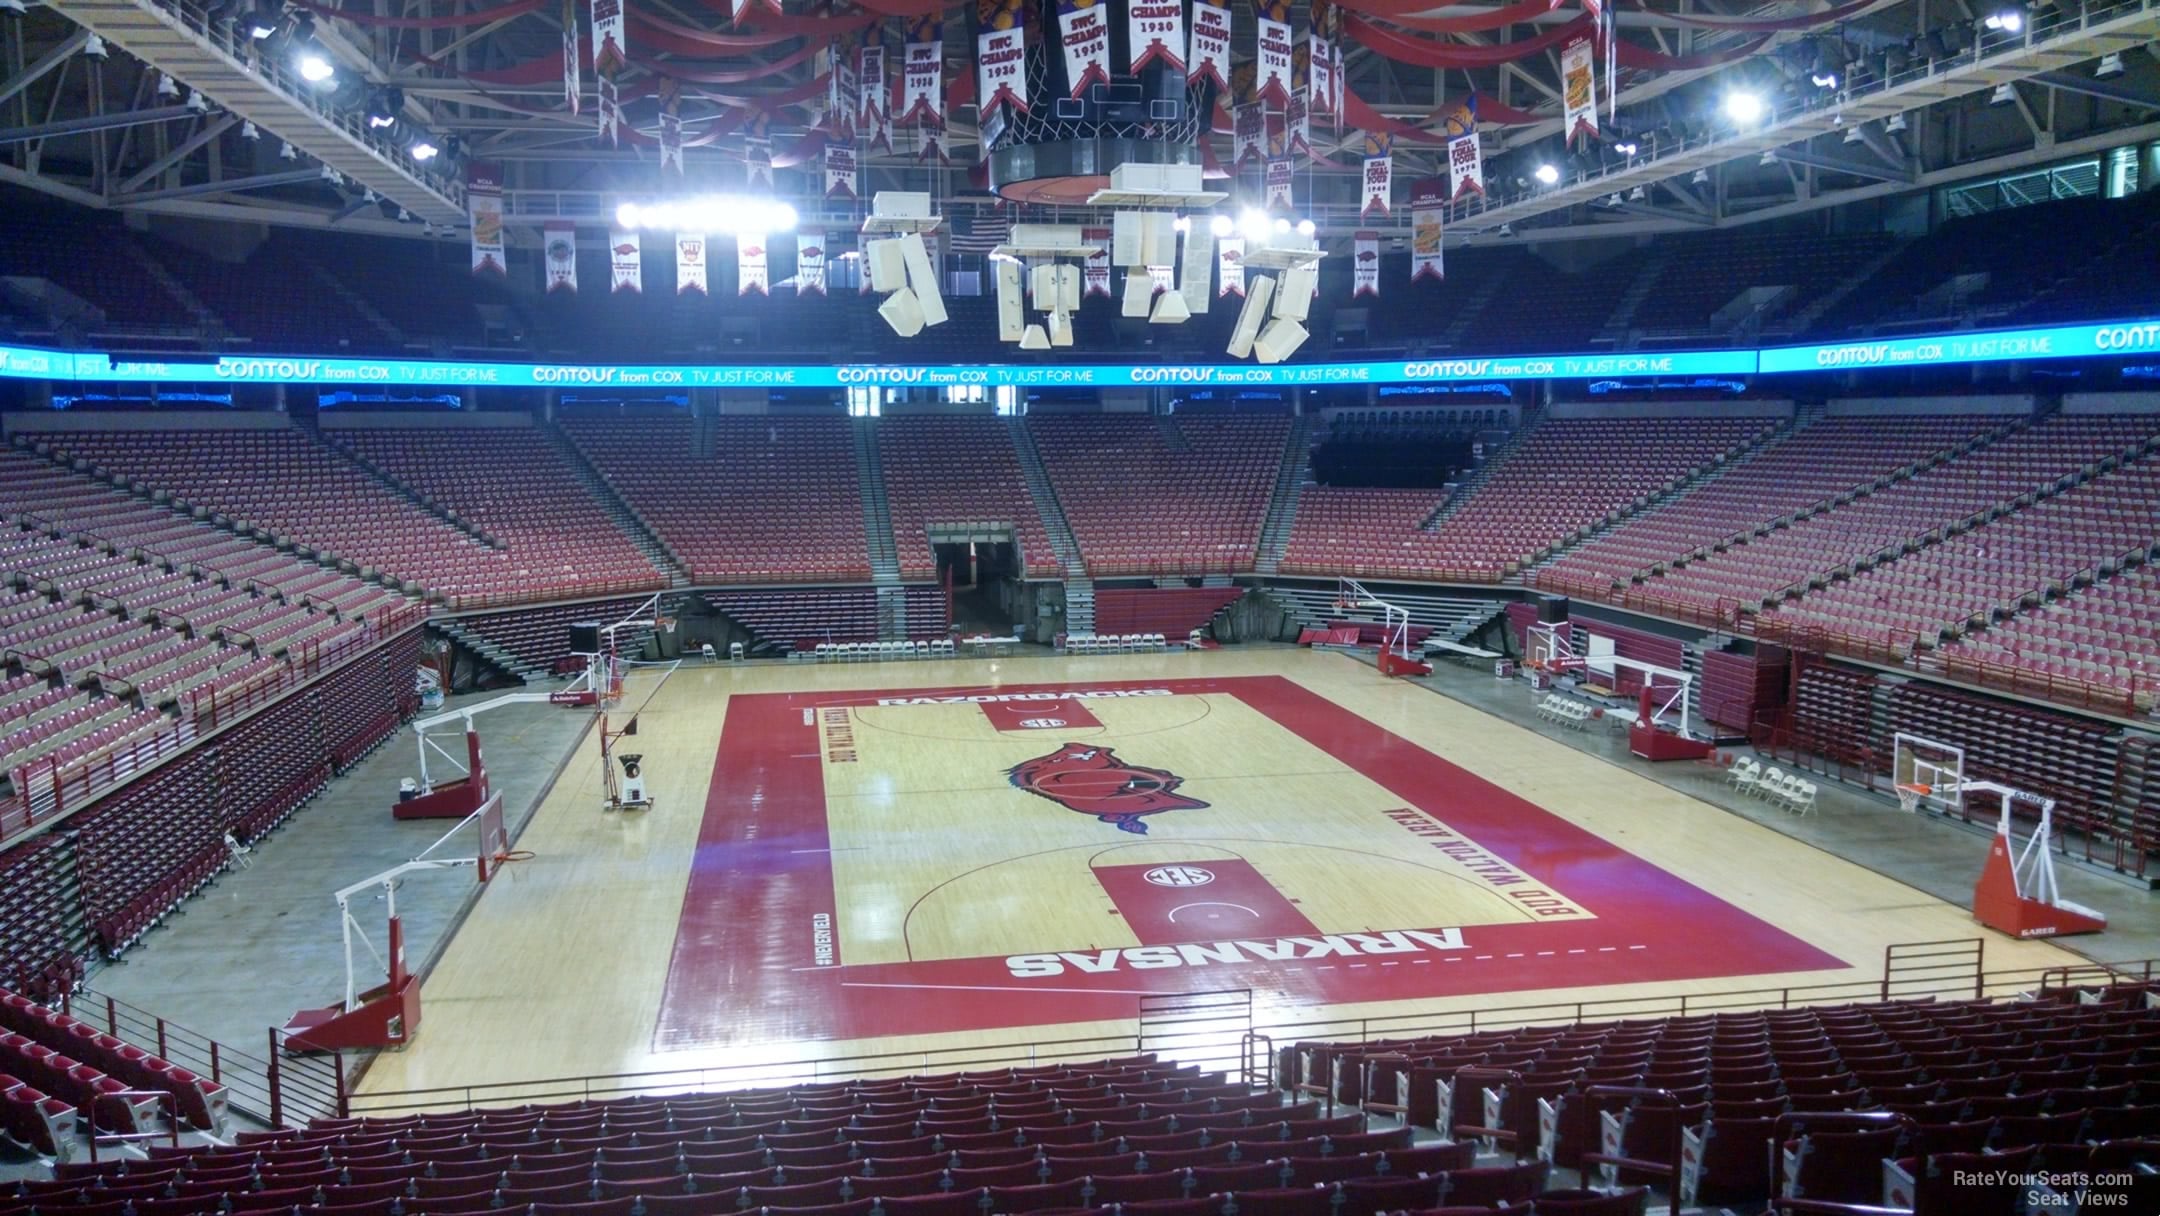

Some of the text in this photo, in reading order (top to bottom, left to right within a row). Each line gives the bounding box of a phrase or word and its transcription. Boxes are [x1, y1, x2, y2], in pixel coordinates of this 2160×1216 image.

[1131, 5, 1181, 19] CHAMPS
[1200, 10, 1222, 26] SWC
[1071, 12, 1096, 31] SWC
[1140, 21, 1174, 33] 1930
[1193, 22, 1229, 42] CHAMPS
[988, 36, 1012, 51] SWC
[1197, 38, 1223, 54] 1929
[980, 48, 1023, 66] CHAMPS
[1890, 347, 1914, 362] from
[1916, 344, 1943, 361] COX
[1951, 342, 1967, 358] TV
[1968, 340, 1998, 357] JUST
[2001, 339, 2029, 355] FOR
[2031, 337, 2051, 353] ME
[324, 366, 355, 379] from
[358, 365, 391, 380] COX
[400, 366, 416, 380] TV
[418, 367, 448, 380] JUST
[451, 367, 477, 381] FOR
[479, 368, 498, 381] ME
[1217, 371, 1243, 382] from
[1246, 370, 1273, 381] COX
[1281, 370, 1296, 380] TV
[1298, 369, 1323, 380] JUST
[1326, 368, 1350, 380] FOR
[1352, 368, 1369, 379] ME
[1493, 363, 1521, 376] from
[1524, 362, 1555, 375] COX
[1564, 361, 1581, 373] TV
[1584, 360, 1615, 373] JUST
[1619, 359, 1648, 372] FOR
[1651, 358, 1673, 371] ME
[620, 371, 649, 383] from
[653, 371, 683, 382] COX
[692, 371, 709, 382] TV
[712, 371, 742, 383] JUST
[745, 371, 772, 383] FOR
[775, 371, 796, 383] ME
[930, 371, 957, 383] from
[959, 370, 988, 382] COX
[997, 370, 1012, 382] TV
[1015, 370, 1044, 382] JUST
[1047, 370, 1072, 382] FOR
[1075, 370, 1093, 382] ME
[878, 689, 1173, 706] RAZORBACKS
[1381, 807, 1580, 917] BUD WALTON ARENA
[1146, 866, 1212, 886] SEC
[813, 913, 833, 966] #NEVERYIELD
[1006, 927, 1472, 979] ARKANSAS
